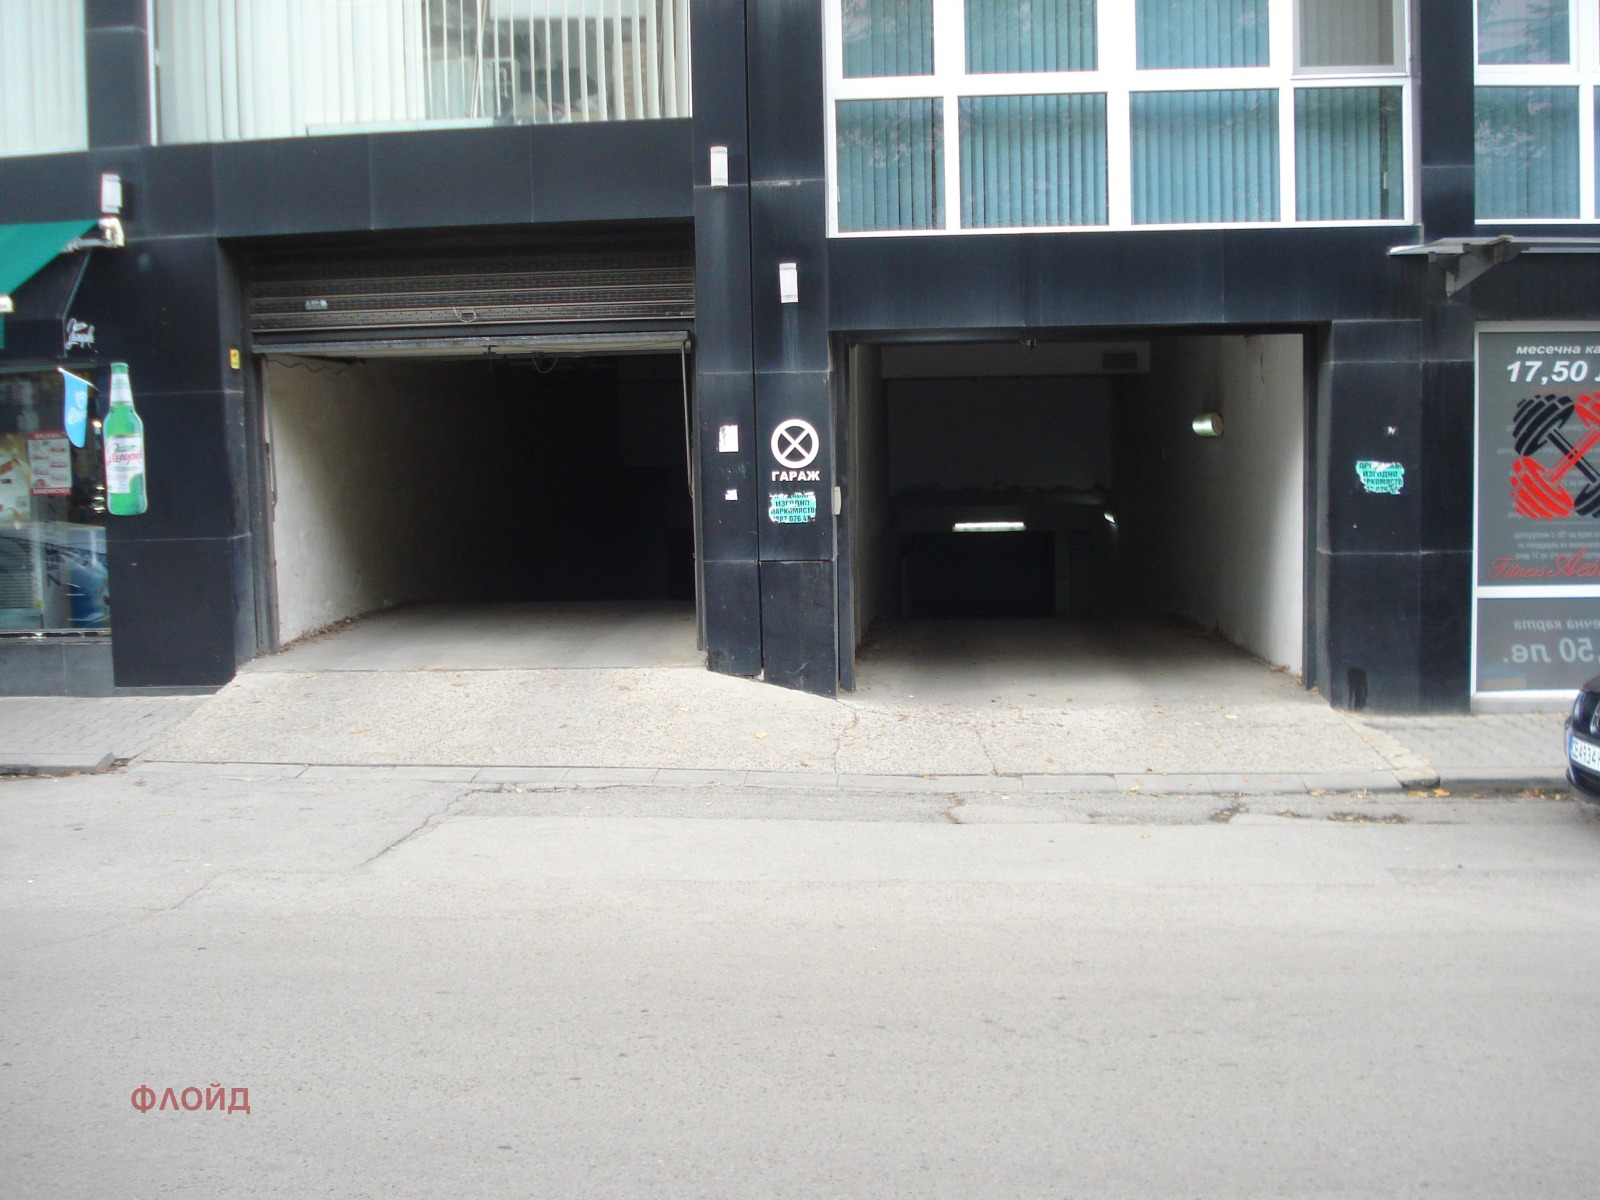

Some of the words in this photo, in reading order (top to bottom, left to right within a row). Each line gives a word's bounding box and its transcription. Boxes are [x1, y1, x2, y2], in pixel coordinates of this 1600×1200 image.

[1516, 345, 1581, 355] месечна
[1506, 360, 1588, 386] 17,50
[771, 470, 820, 482] ГАРАЖ
[1363, 478, 1403, 486] РКОМЯСТО
